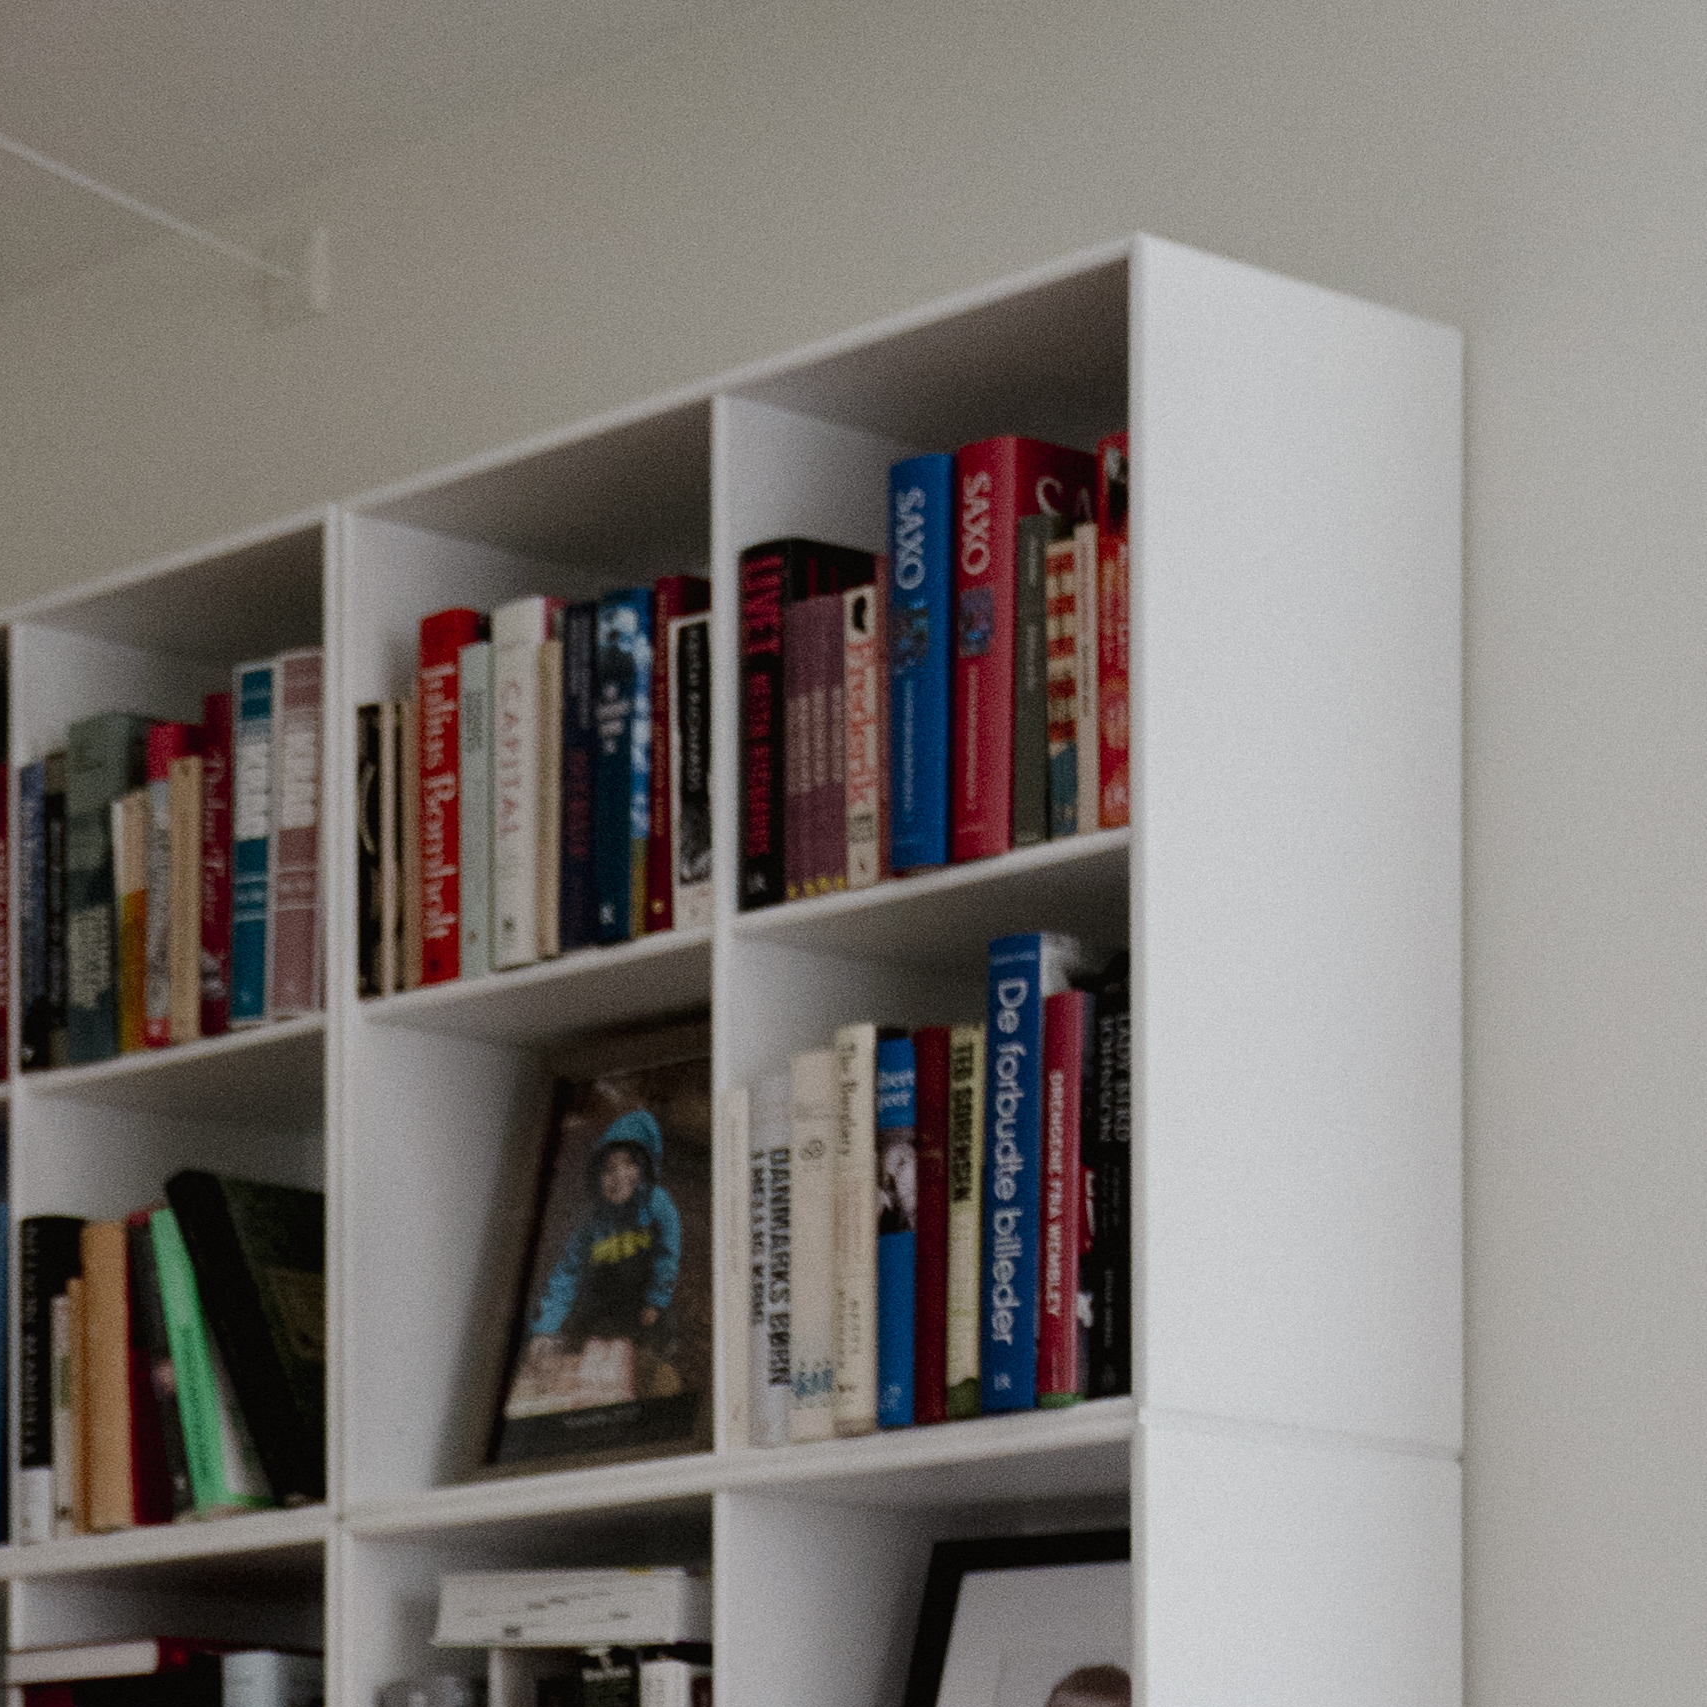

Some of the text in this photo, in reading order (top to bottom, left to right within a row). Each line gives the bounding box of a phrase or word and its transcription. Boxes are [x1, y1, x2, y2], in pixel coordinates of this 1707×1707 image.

[894, 486, 927, 590] SAXO
[960, 470, 992, 576] SAXO
[422, 661, 457, 939] Julius Bomholt
[500, 680, 522, 836] CAPITAL
[770, 1147, 791, 1303] DANMARKS
[992, 977, 1028, 1346] De forbudte billeder
[1046, 1070, 1064, 1317] DRENGENE FRA WEMBLEY
